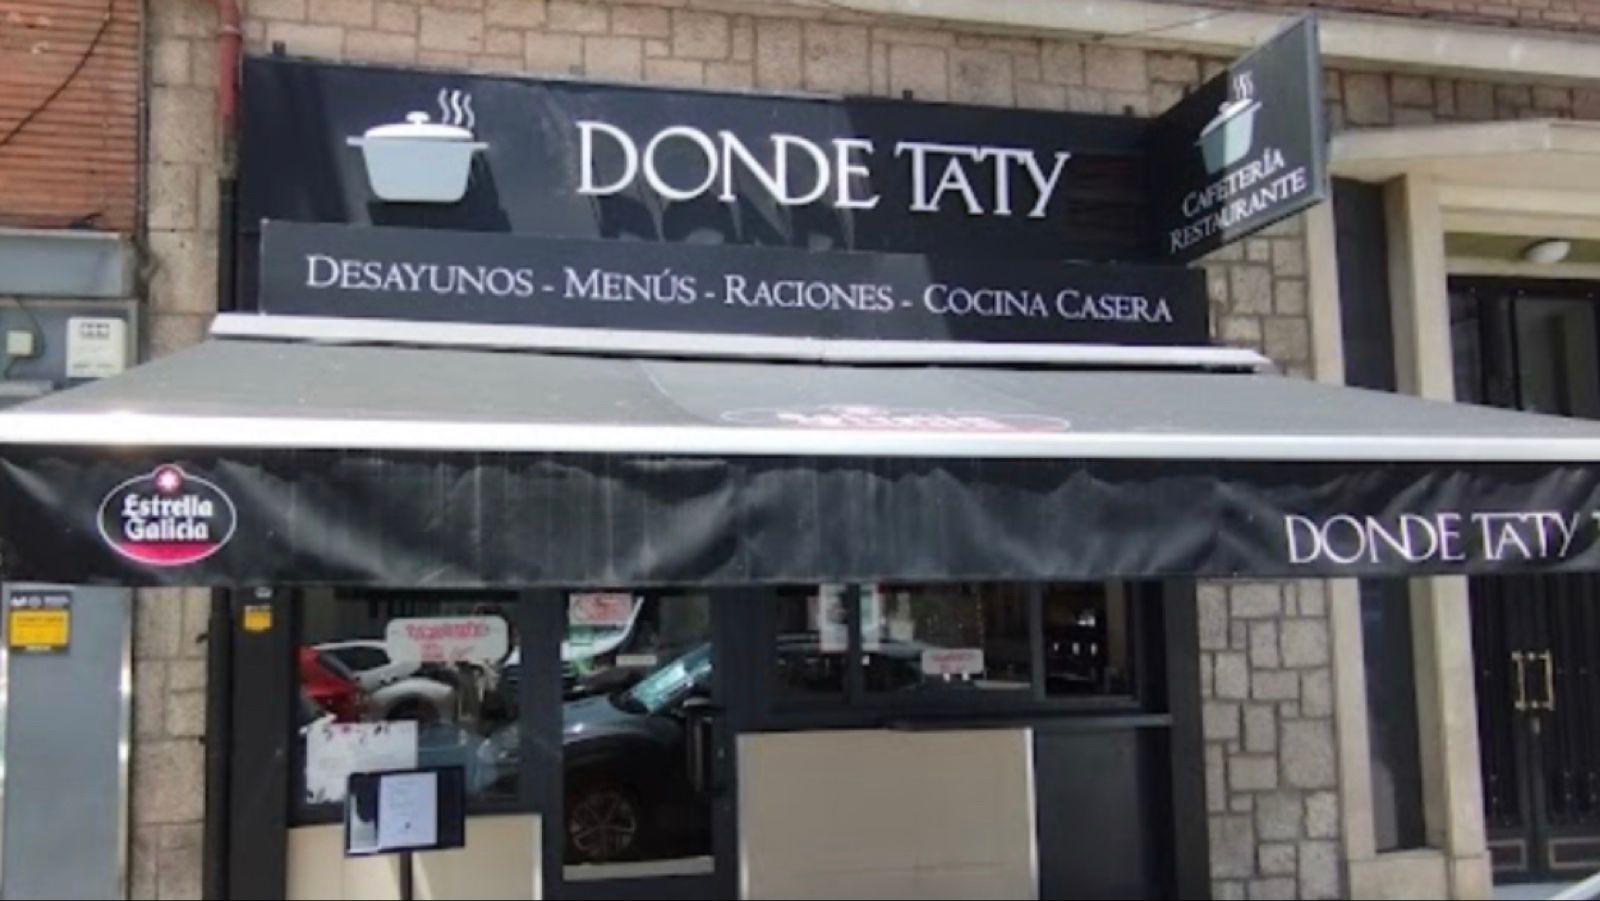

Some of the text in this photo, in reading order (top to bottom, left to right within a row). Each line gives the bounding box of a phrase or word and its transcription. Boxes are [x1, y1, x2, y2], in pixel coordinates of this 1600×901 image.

[575, 120, 1070, 217] DONDE TATY
[1182, 147, 1286, 218] CAFETERÍA
[1169, 167, 1308, 255] RESTAURANTE
[306, 255, 534, 297] DESAYUNOS
[564, 267, 697, 304] MENÚS
[724, 274, 894, 312] RACIONES
[923, 284, 1047, 315] COCINA
[1056, 291, 1171, 321] CASERA
[121, 494, 214, 517] Estrella
[125, 518, 209, 541] Galicia
[1284, 512, 1464, 565] DONDE
[1471, 510, 1580, 561] TATY
